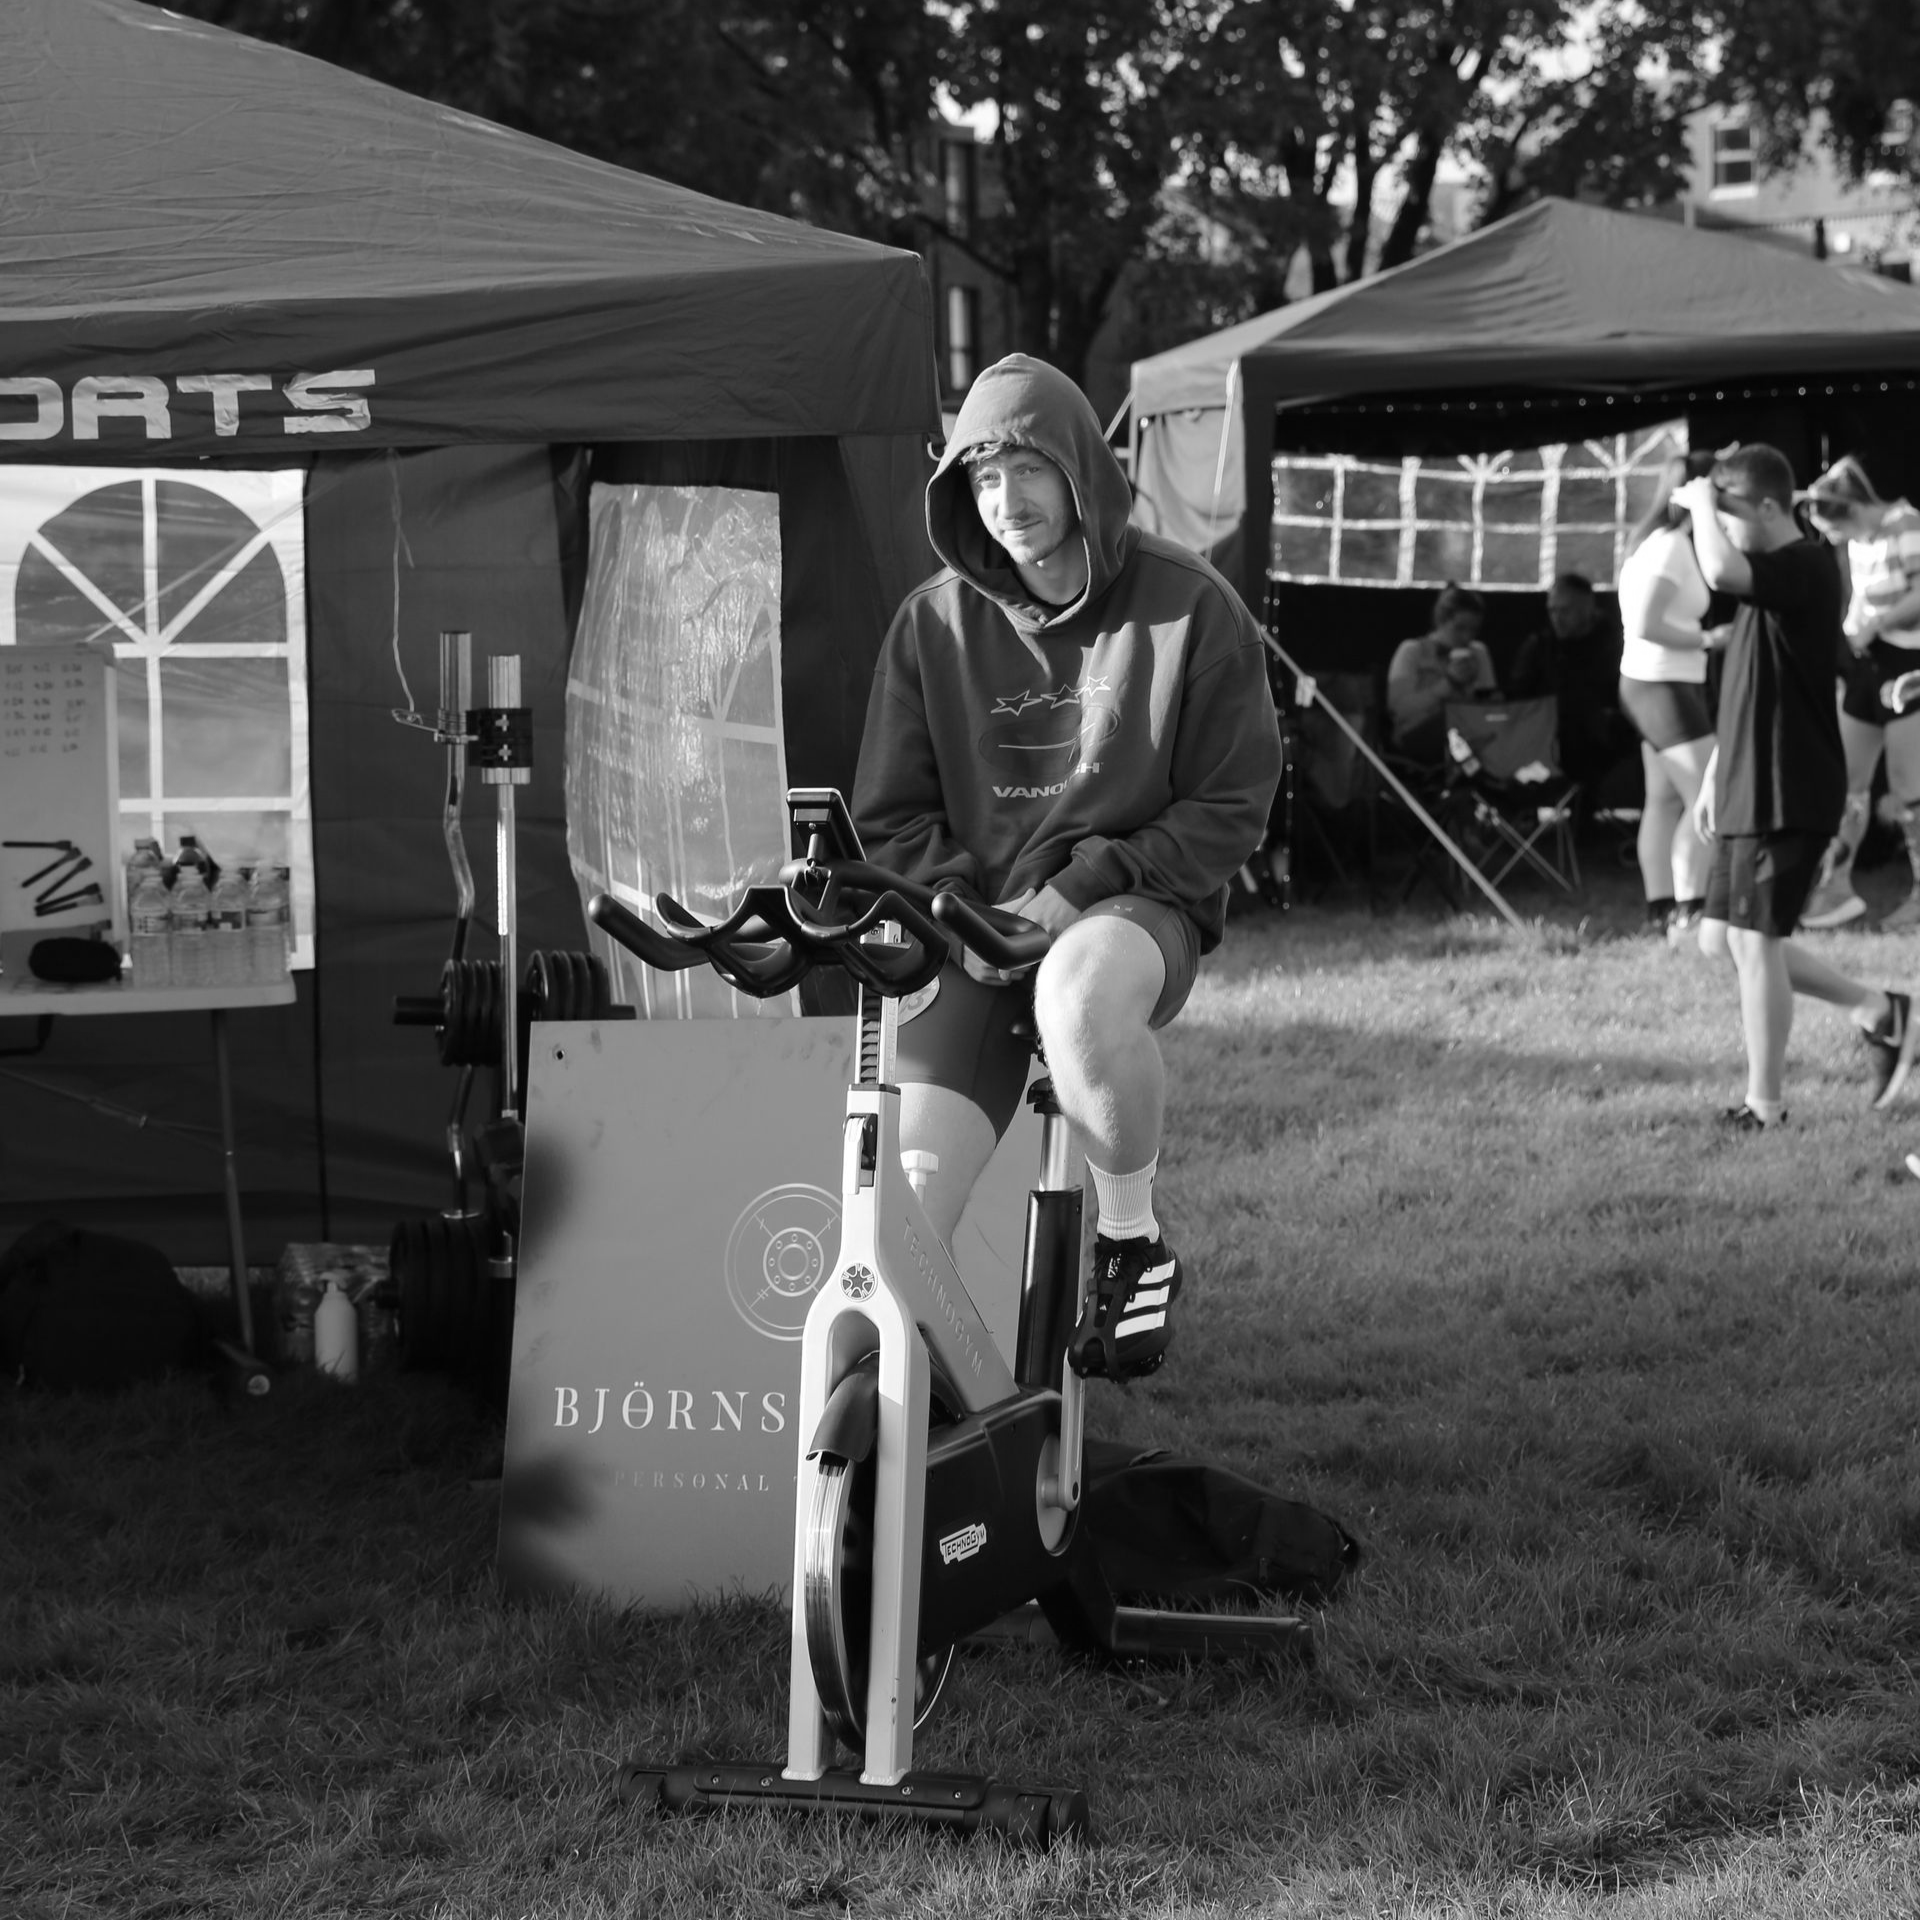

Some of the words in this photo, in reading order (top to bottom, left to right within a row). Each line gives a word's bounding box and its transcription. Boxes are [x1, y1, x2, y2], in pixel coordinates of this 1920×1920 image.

[903, 1216, 983, 1377] TECHNOGYM
[553, 1381, 786, 1433] BJÖRNS
[614, 1470, 769, 1492] PERSONAL
